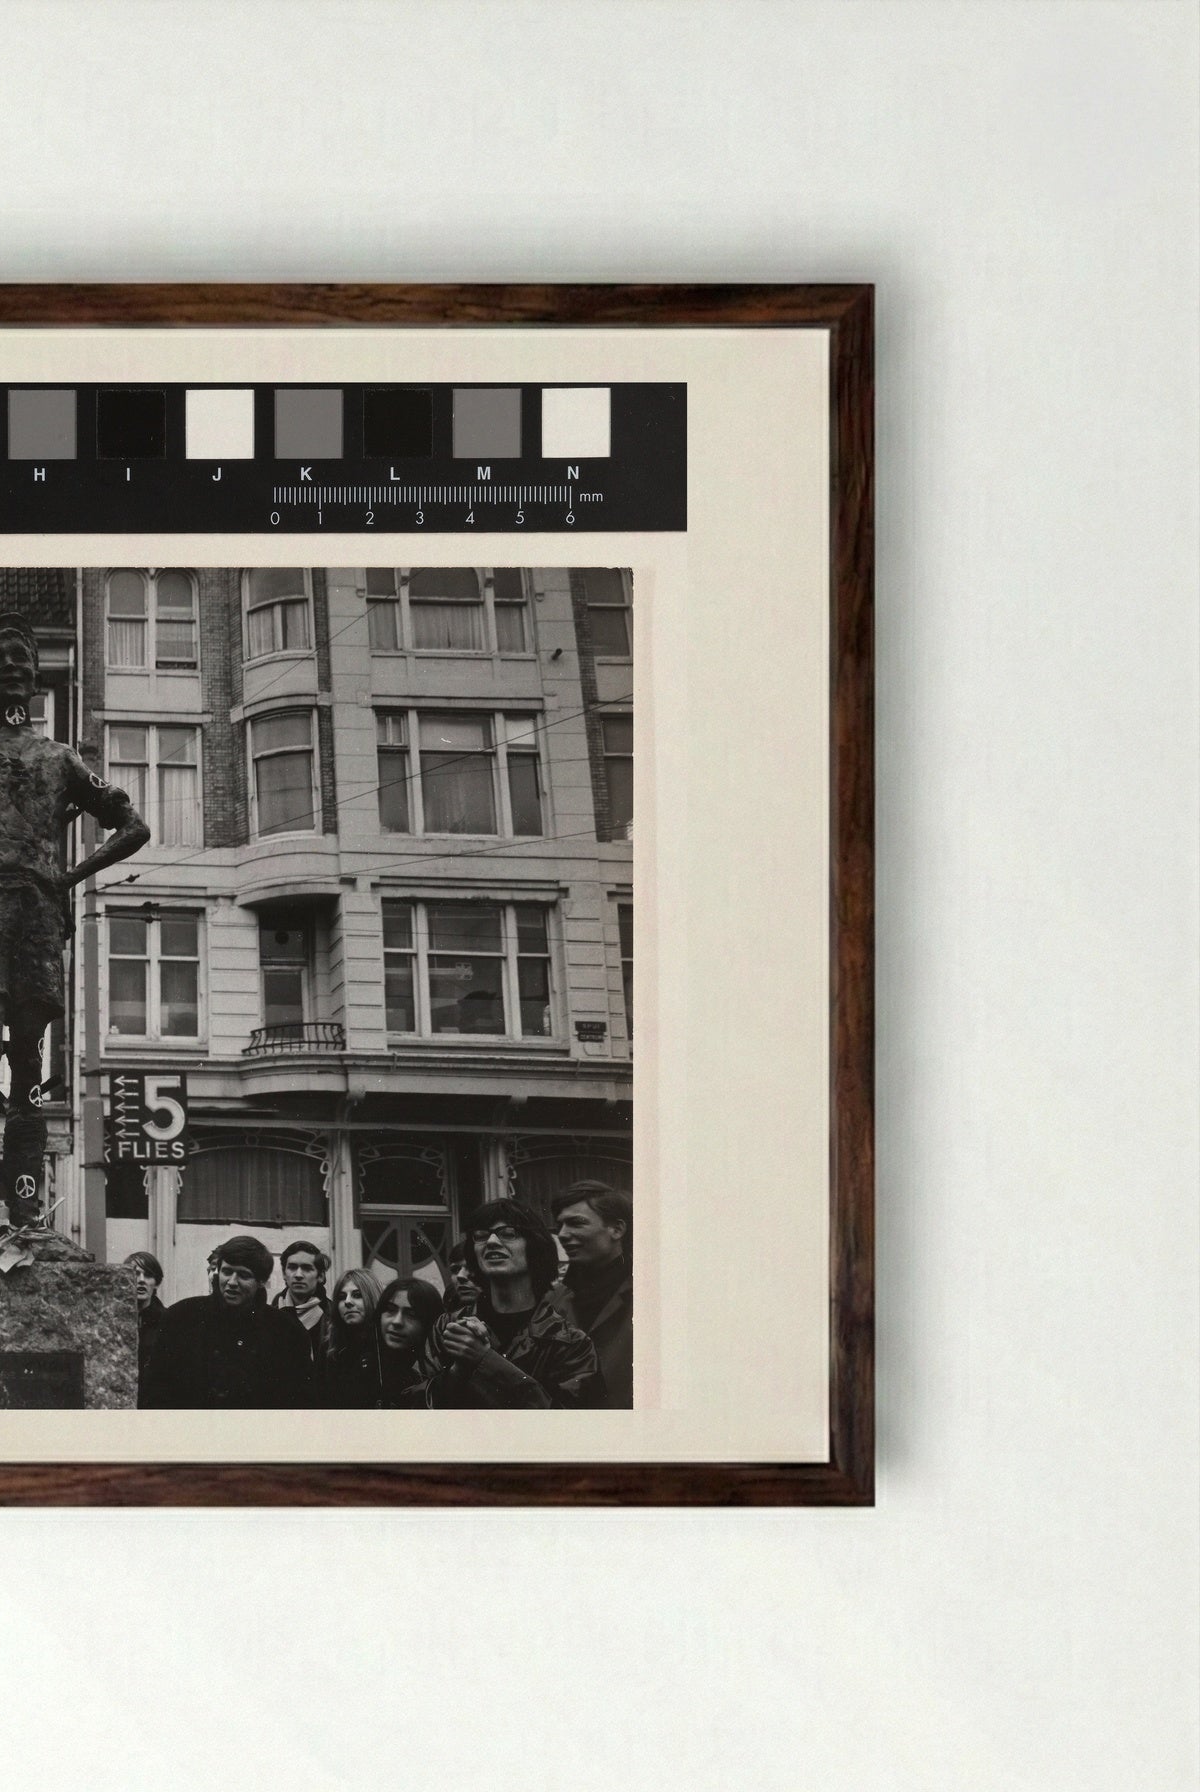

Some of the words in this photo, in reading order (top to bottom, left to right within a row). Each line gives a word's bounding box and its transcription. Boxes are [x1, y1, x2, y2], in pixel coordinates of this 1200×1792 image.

[34, 467, 46, 482] H
[212, 467, 222, 482] J
[300, 466, 313, 481] K
[390, 466, 401, 481] L
[477, 466, 491, 481] M
[567, 465, 579, 480] N
[579, 493, 603, 502] mm
[365, 511, 375, 525] 2
[415, 511, 424, 525] 3
[465, 511, 475, 524] 4
[515, 510, 525, 525] 5
[565, 510, 575, 524] 6
[141, 1075, 186, 1141] 5
[117, 1141, 186, 1159] FLIES
